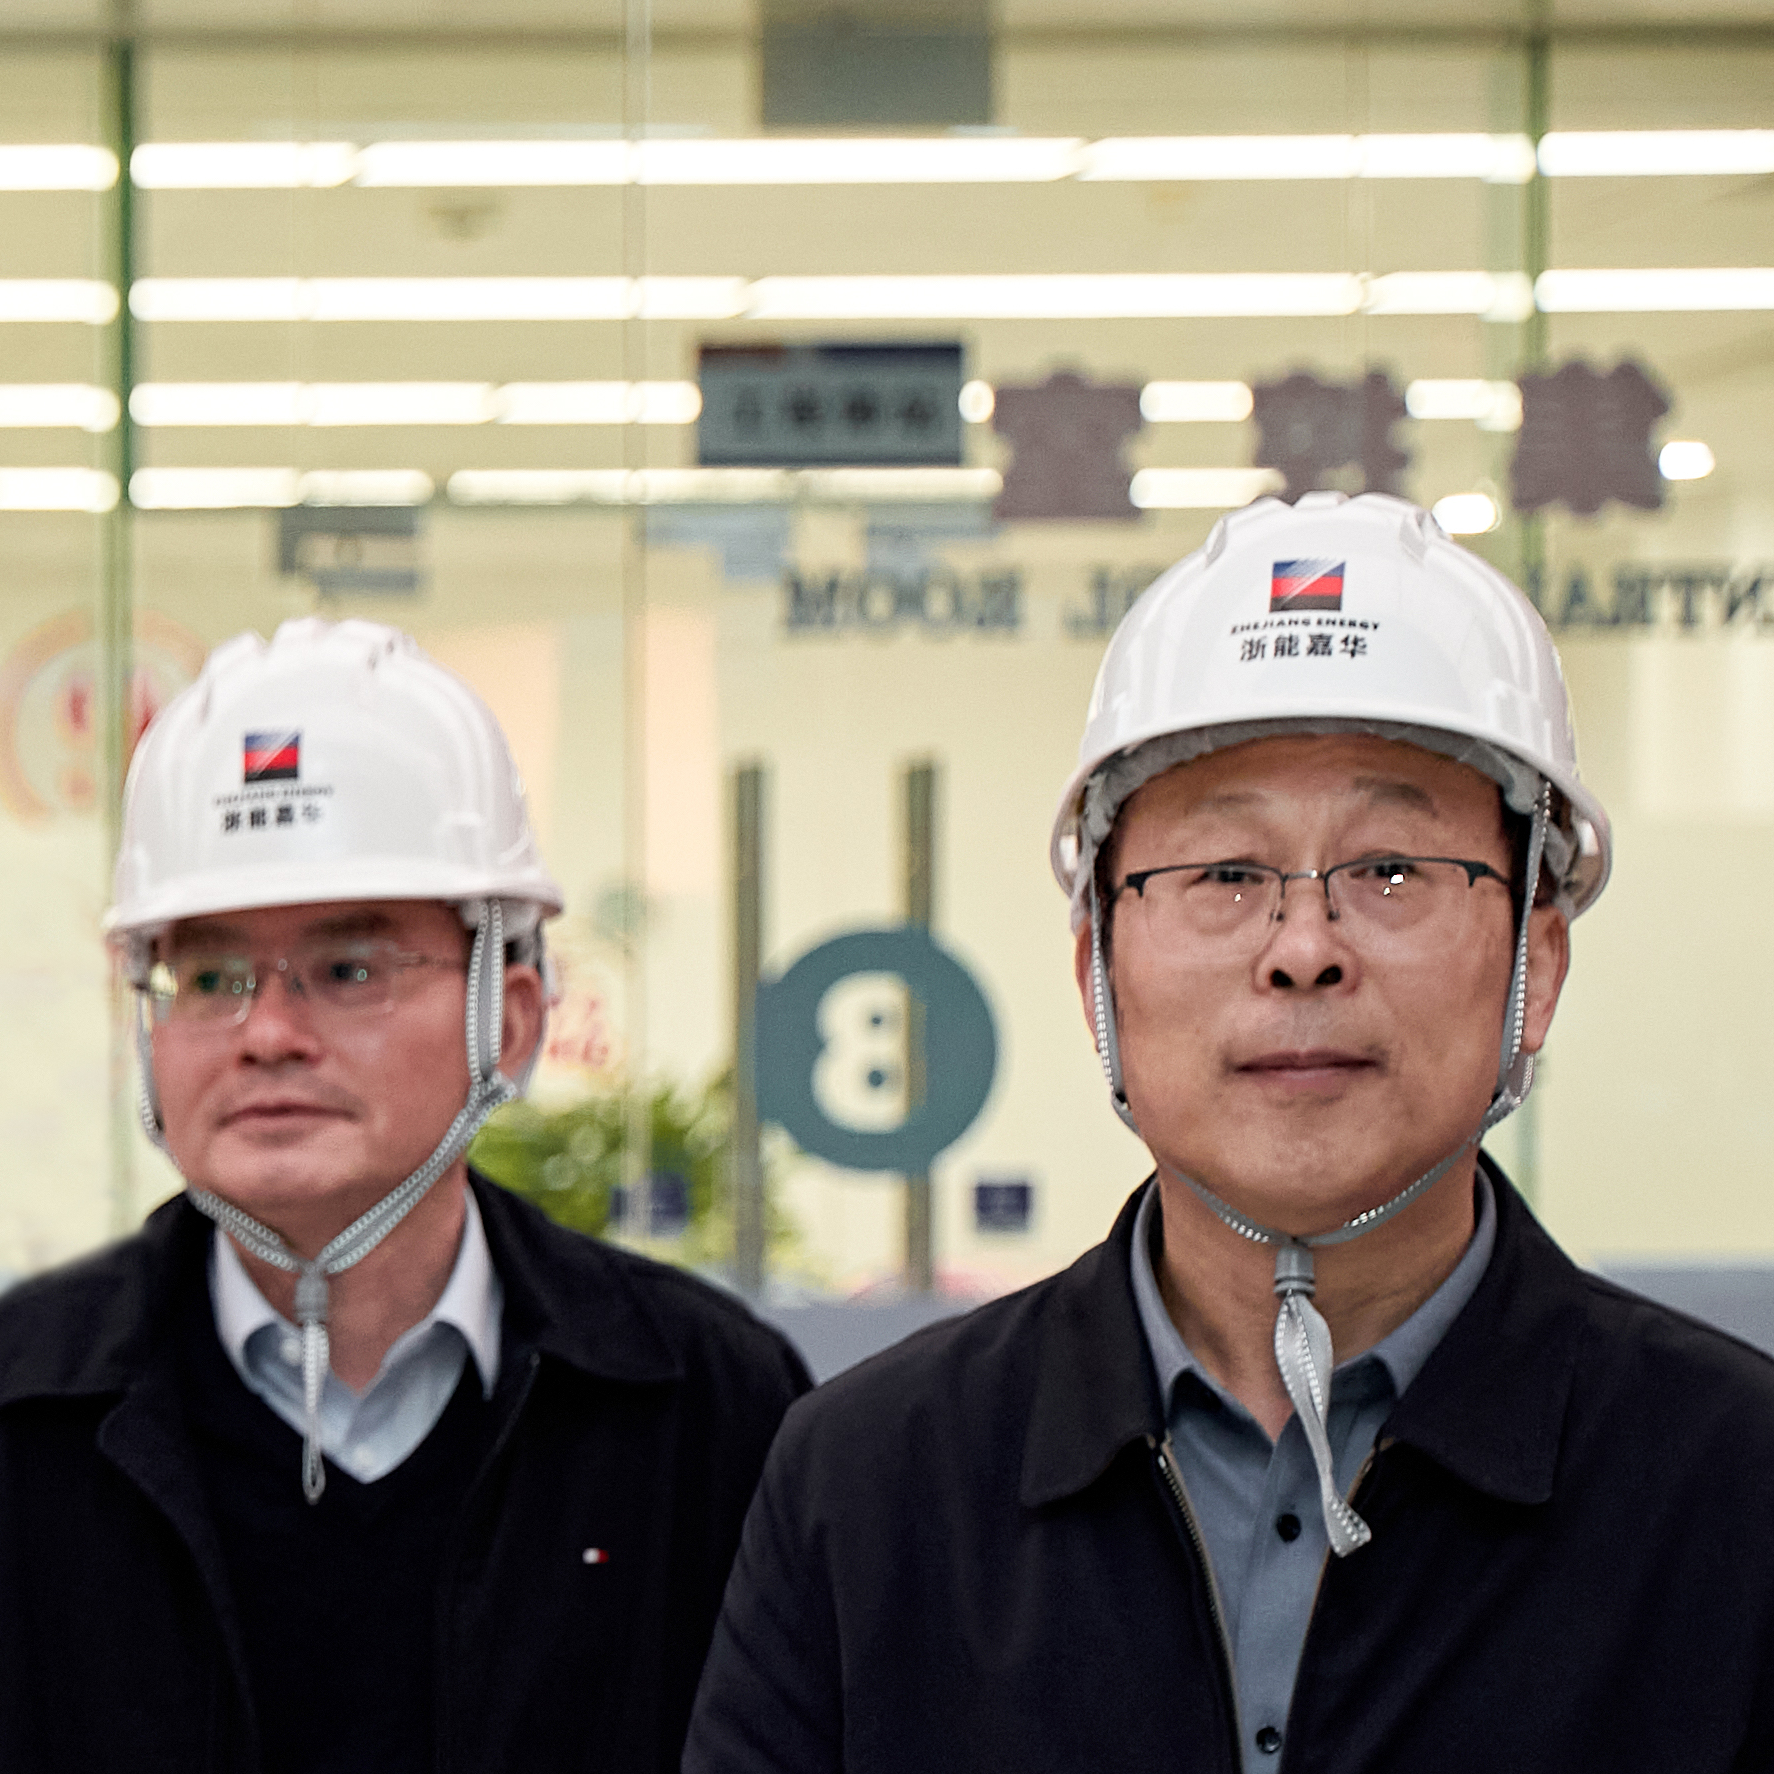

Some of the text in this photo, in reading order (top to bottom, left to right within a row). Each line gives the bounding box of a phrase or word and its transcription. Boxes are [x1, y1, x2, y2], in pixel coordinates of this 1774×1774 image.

[1231, 618, 1380, 634] ZHEJIANG ENERGY
[1240, 633, 1368, 661] 浙能嘉华
